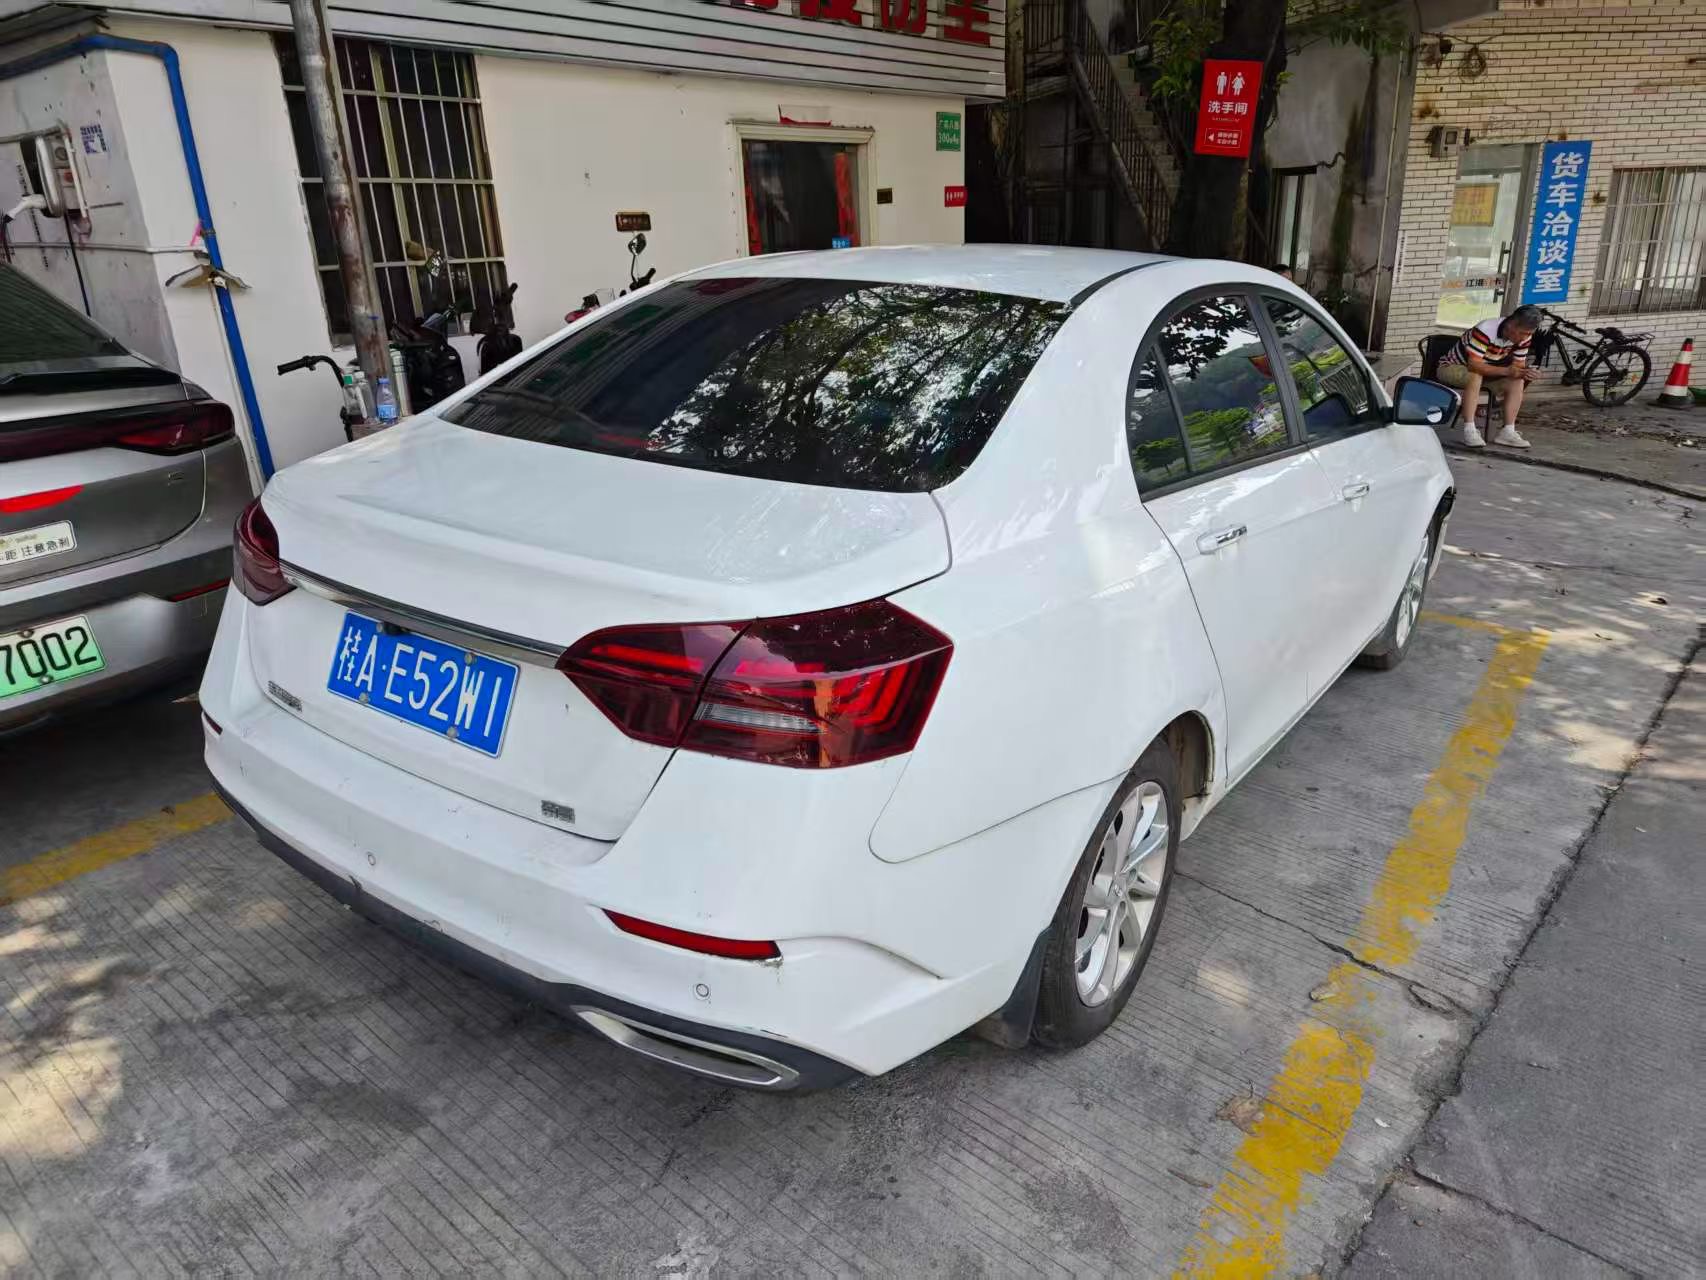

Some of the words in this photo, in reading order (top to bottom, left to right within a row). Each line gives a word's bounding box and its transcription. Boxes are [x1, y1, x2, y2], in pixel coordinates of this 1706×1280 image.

[1208, 100, 1248, 115] 洗手间
[1532, 151, 1585, 294] 货车洽谈室
[21, 535, 70, 557] 注意急刹
[0, 626, 97, 685] 7002
